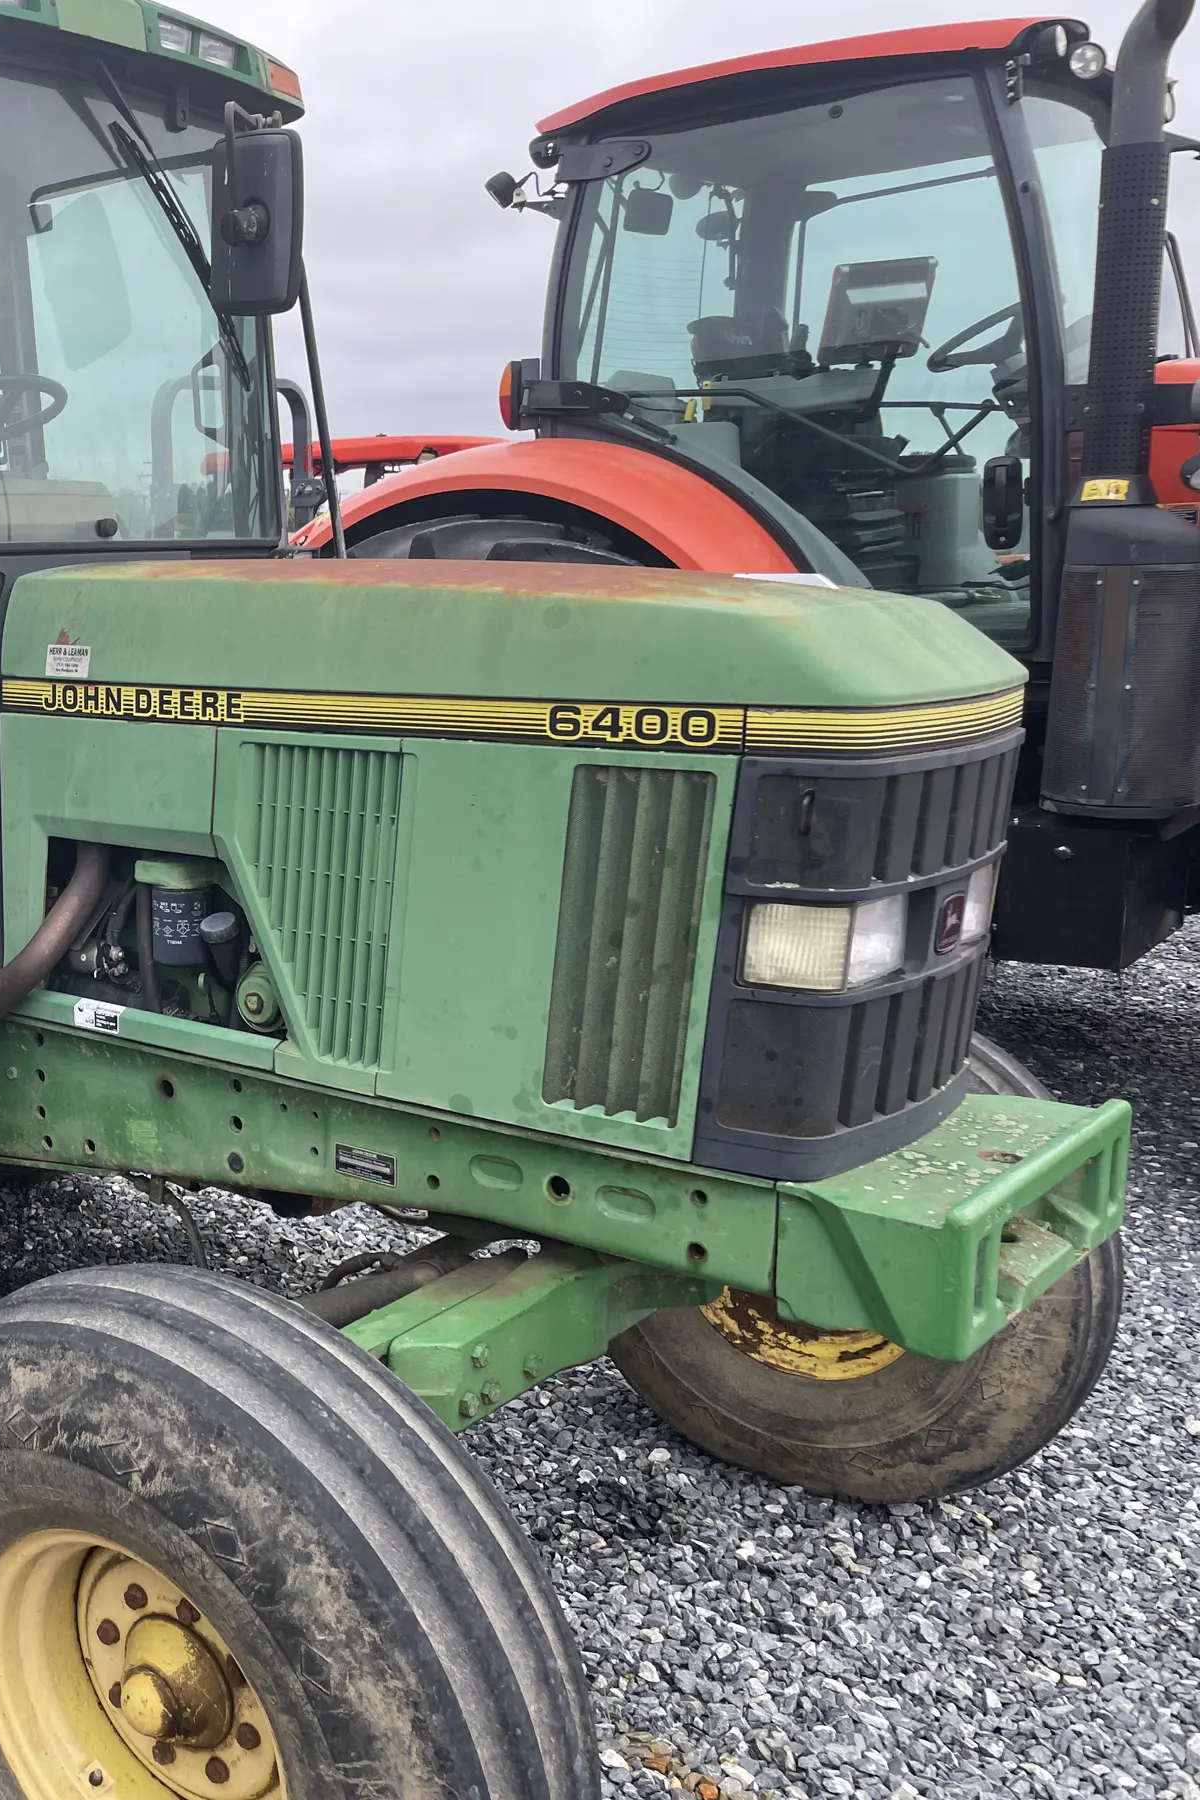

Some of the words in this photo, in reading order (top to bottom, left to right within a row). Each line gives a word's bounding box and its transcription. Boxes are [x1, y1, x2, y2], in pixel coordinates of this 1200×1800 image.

[49, 647, 63, 656] HERR
[63, 648, 68, 656] &
[68, 648, 89, 657] LEAMAN
[43, 683, 123, 715] JOHN
[133, 688, 244, 722] DEERE
[546, 704, 718, 746] 6400
